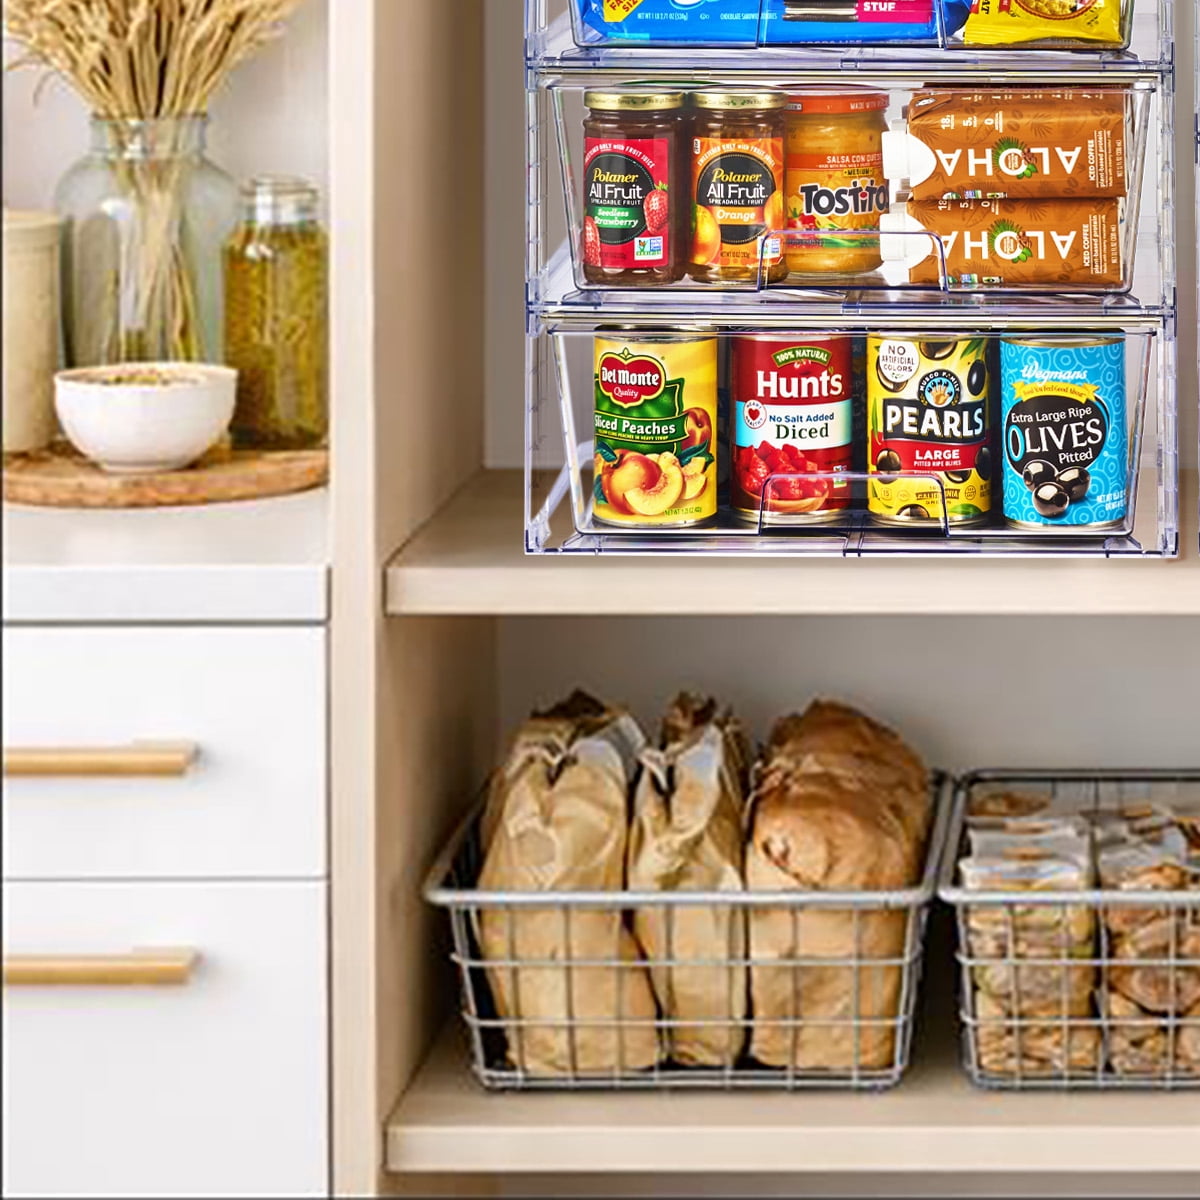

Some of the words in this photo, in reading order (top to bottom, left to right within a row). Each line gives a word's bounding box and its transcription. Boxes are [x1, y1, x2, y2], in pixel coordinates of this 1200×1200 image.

[863, 2, 896, 12] STUF
[1096, 131, 1104, 152] protein
[626, 146, 642, 158] FRUIT
[641, 153, 656, 168] JUICE
[826, 155, 850, 164] SALSA
[851, 154, 865, 163] CON
[936, 147, 1082, 177] ALOHA
[593, 167, 639, 183] Polaner
[711, 167, 762, 183] Polaner
[1088, 166, 1096, 181] ICED
[589, 183, 602, 198] All
[604, 184, 643, 199] Fruit
[706, 183, 724, 198] All
[728, 183, 766, 199] Fruit
[597, 209, 629, 217] Seedless
[716, 209, 756, 222] Orange
[594, 216, 638, 228] Strawberry
[1091, 215, 1100, 237] protein
[776, 351, 795, 363] 100%
[795, 349, 829, 362] NATURAL
[888, 345, 907, 355] NO
[881, 355, 915, 366] ARTIFICIAL
[883, 364, 913, 373] COLORS
[602, 366, 617, 384] Del
[618, 368, 660, 386] Monte
[1020, 360, 1089, 386] Wegmans
[757, 369, 843, 398] Hunt's
[919, 371, 939, 392] MUSCO
[613, 386, 639, 399] Quality
[769, 414, 782, 423] No
[784, 413, 803, 423] Salt
[805, 412, 835, 422] Added
[886, 404, 984, 438] PEARLS
[1011, 411, 1033, 423] Extra
[1036, 410, 1066, 423] Large
[1068, 405, 1092, 417] Ripe
[594, 414, 618, 431] Sliced
[622, 419, 676, 435] Peaches
[775, 422, 830, 440] Diced
[1008, 418, 1103, 462] OLIVES
[915, 449, 960, 460] LARGE
[1058, 449, 1093, 465] Pitted
